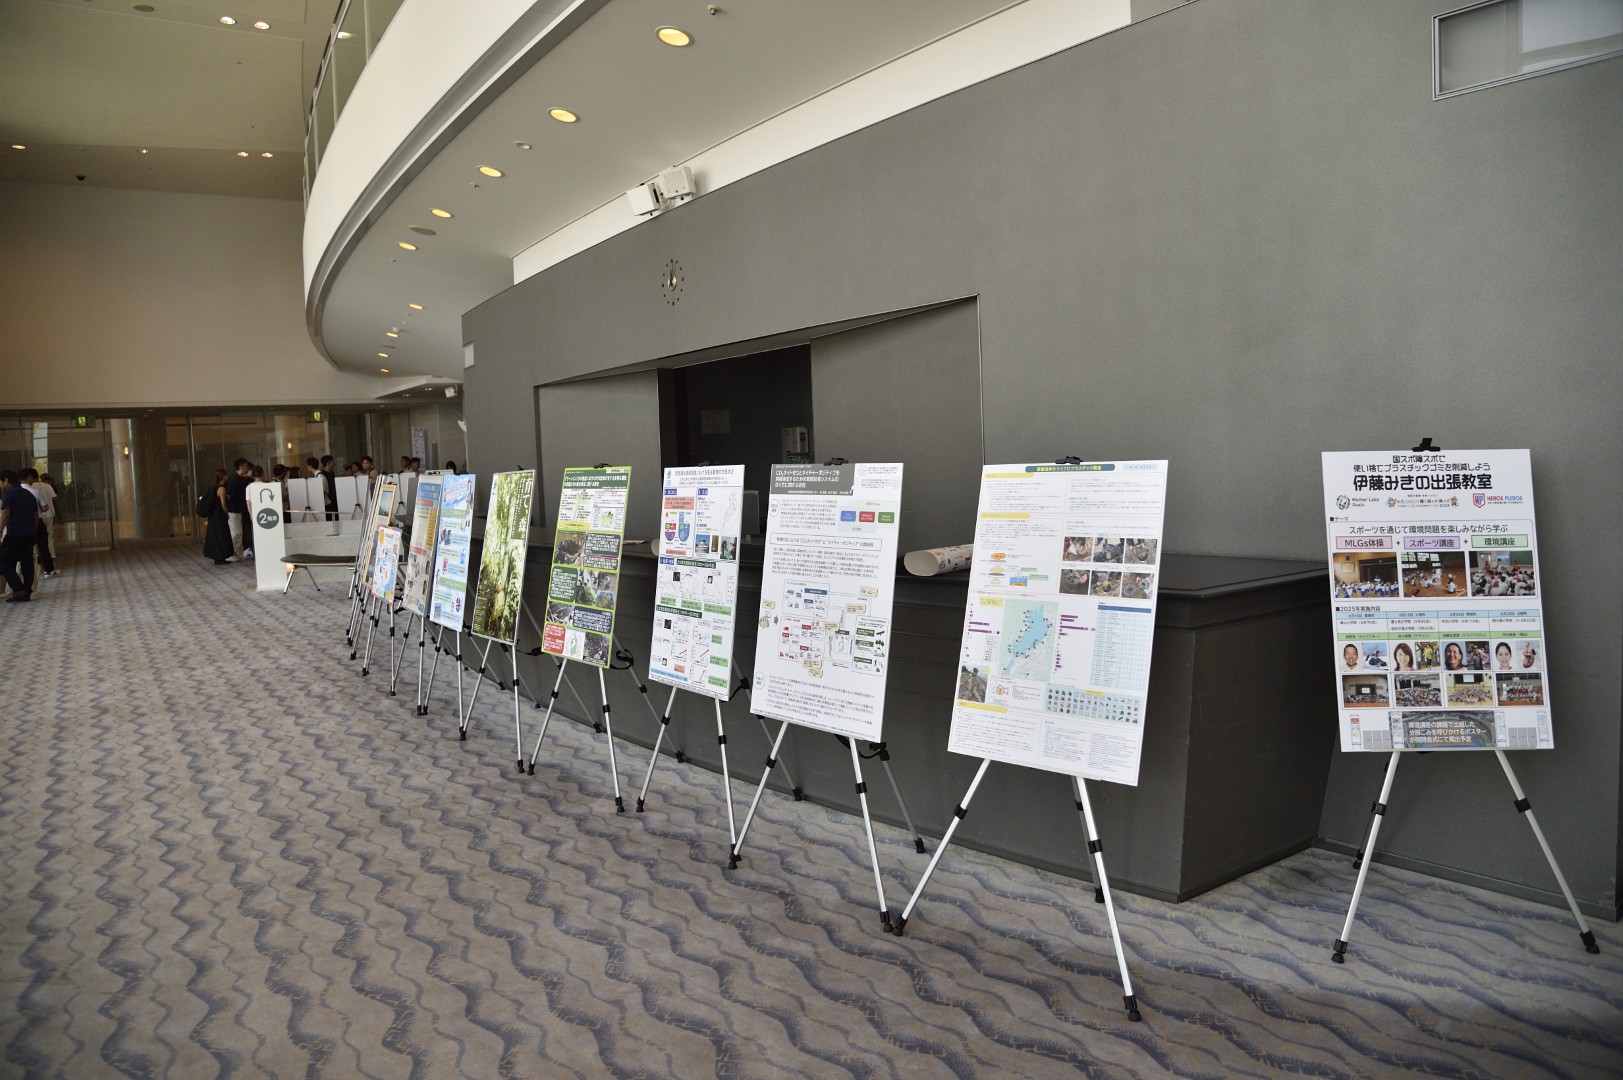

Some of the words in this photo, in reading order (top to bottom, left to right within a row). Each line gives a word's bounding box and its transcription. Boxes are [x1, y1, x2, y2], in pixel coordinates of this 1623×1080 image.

[1393, 455, 1446, 463] 国スポ障スポで
[1353, 463, 1490, 472] 使い捨てプラスチックゴミを削減しよう
[1353, 474, 1492, 491] 伊藤みきの出張教室
[1349, 524, 1508, 534] スポーツを通じて環境問題を楽しみながら学ぶ
[1344, 539, 1384, 548] MLGs体操
[1410, 539, 1454, 548] スポーツ講座
[1484, 538, 1515, 546] 環境講座
